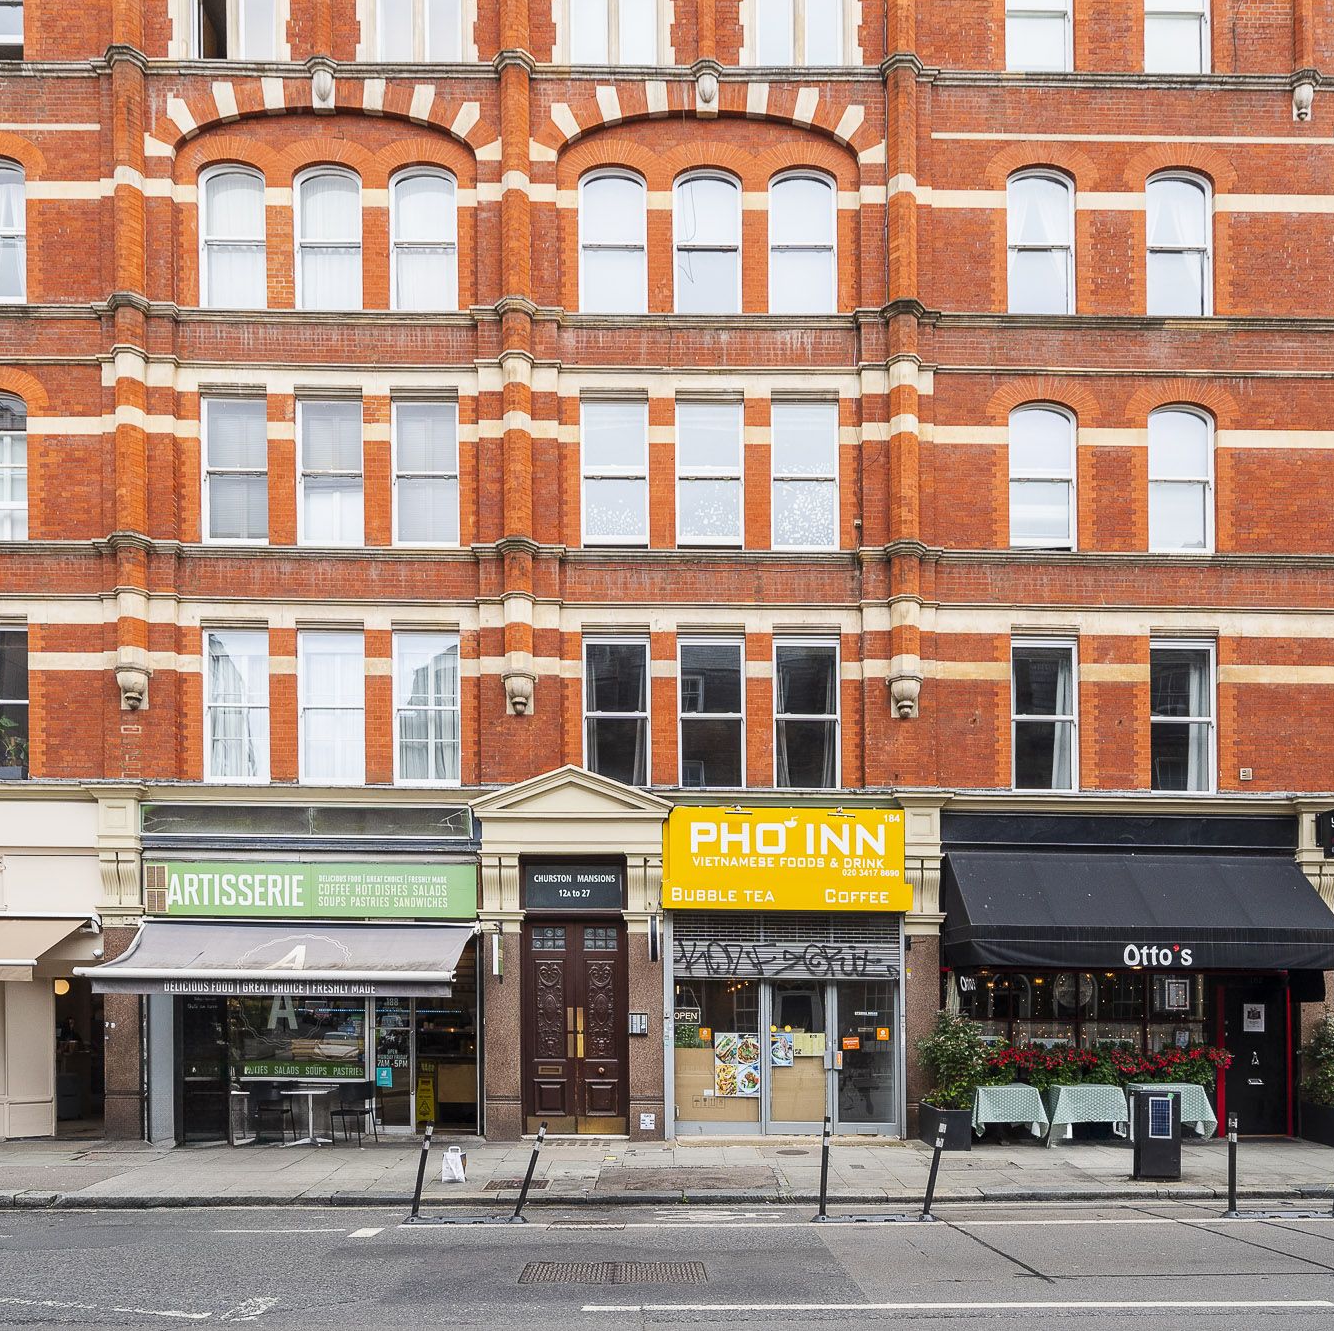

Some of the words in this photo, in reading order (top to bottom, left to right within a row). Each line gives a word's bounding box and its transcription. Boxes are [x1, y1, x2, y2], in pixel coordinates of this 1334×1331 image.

[883, 814, 900, 823] 184
[806, 823, 885, 856] INN
[692, 856, 775, 868] VIETNAMESE
[780, 857, 825, 868] FOODS
[829, 857, 838, 868] &
[843, 858, 884, 869] DRINK
[318, 874, 347, 882] DELICIOUS
[366, 875, 383, 883] GREAT
[533, 874, 572, 883] CHURSTON
[577, 874, 616, 883] MANSIONS
[842, 869, 857, 877] 020
[859, 869, 878, 877] 3417
[168, 873, 304, 907] ARTISSERIE
[318, 884, 350, 895] COFFEE
[355, 884, 373, 895] HOT
[375, 885, 408, 896] DISHES
[412, 885, 447, 896] SALADS
[558, 889, 571, 897] 12A
[581, 889, 591, 897] 27
[671, 887, 737, 902] BUBBLE
[743, 890, 775, 902] TEA
[318, 896, 346, 907] SOUPS
[350, 896, 390, 907] PASTRIES
[393, 897, 448, 908] SANDWICHES
[825, 889, 889, 904] COFFEE
[1123, 943, 1193, 966] Otto's
[164, 980, 209, 992] DELICIOUS
[211, 981, 234, 993] FOOD
[242, 981, 268, 993] GREAT
[271, 982, 304, 994] CHOICE
[312, 982, 349, 994] FRESHLY
[351, 983, 376, 995] MADE
[674, 1012, 698, 1020] OPEN
[274, 1066, 300, 1075] SALADS
[305, 1066, 327, 1076] SOUPS
[333, 1067, 364, 1076] PASTRIES
